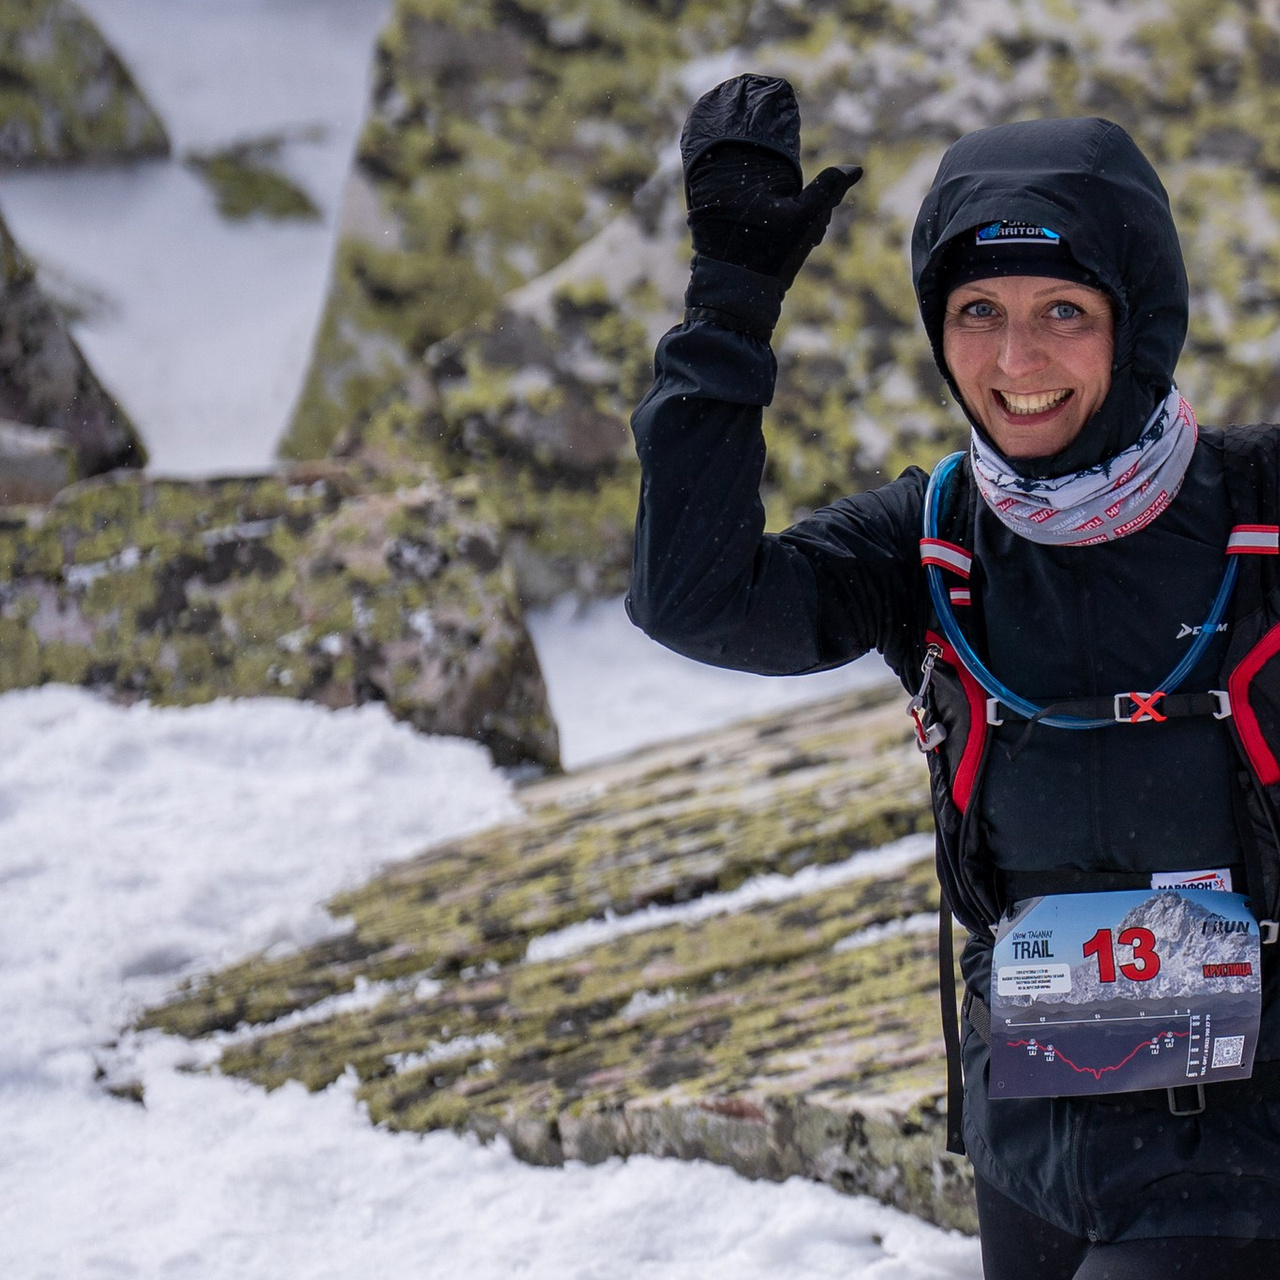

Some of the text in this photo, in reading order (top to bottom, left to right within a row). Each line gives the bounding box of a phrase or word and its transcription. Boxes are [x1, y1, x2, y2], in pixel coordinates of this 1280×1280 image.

[1027, 930, 1054, 939] TAGANAY
[1213, 921, 1250, 934] RUN
[1012, 939, 1054, 959] TRAIL
[1083, 927, 1161, 983] 13
[1203, 962, 1253, 978] КРУГЛИЦА
